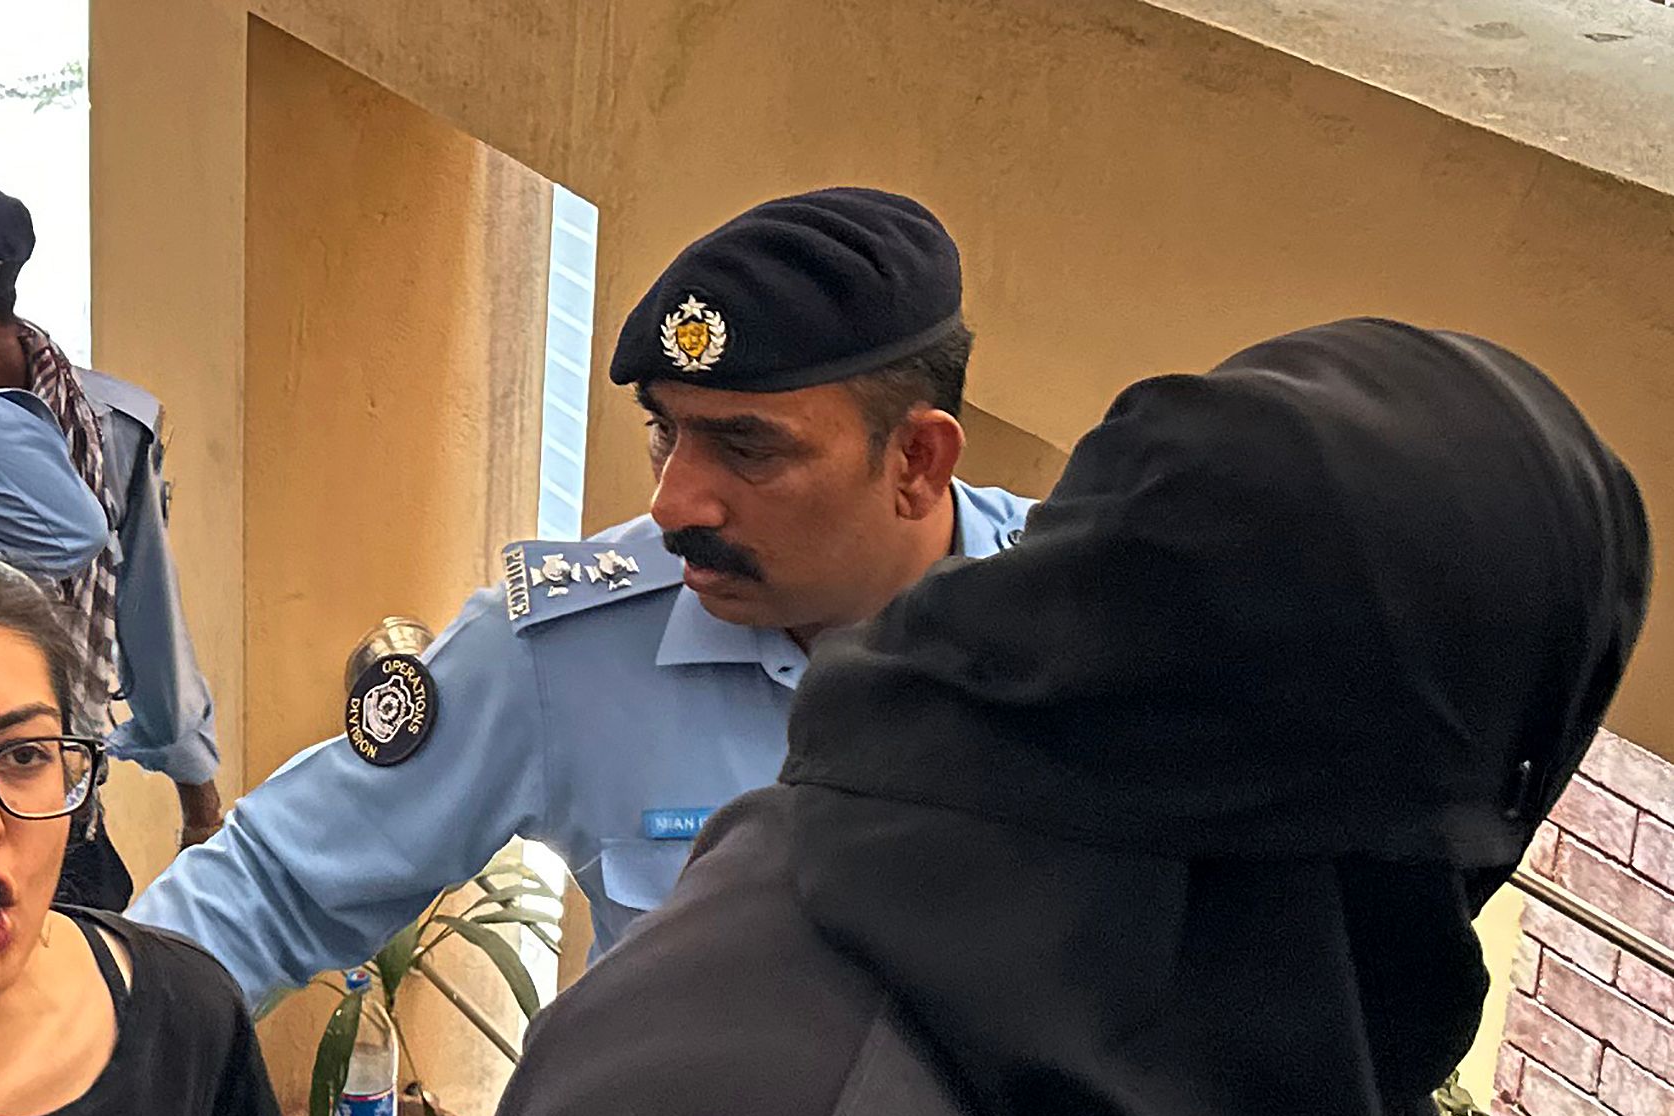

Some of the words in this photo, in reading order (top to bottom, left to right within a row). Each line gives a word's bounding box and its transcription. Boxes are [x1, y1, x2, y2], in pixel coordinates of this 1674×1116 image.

[506, 546, 530, 620] POLICE
[349, 698, 378, 759] DIVISION
[382, 660, 426, 734] OPERATIONS
